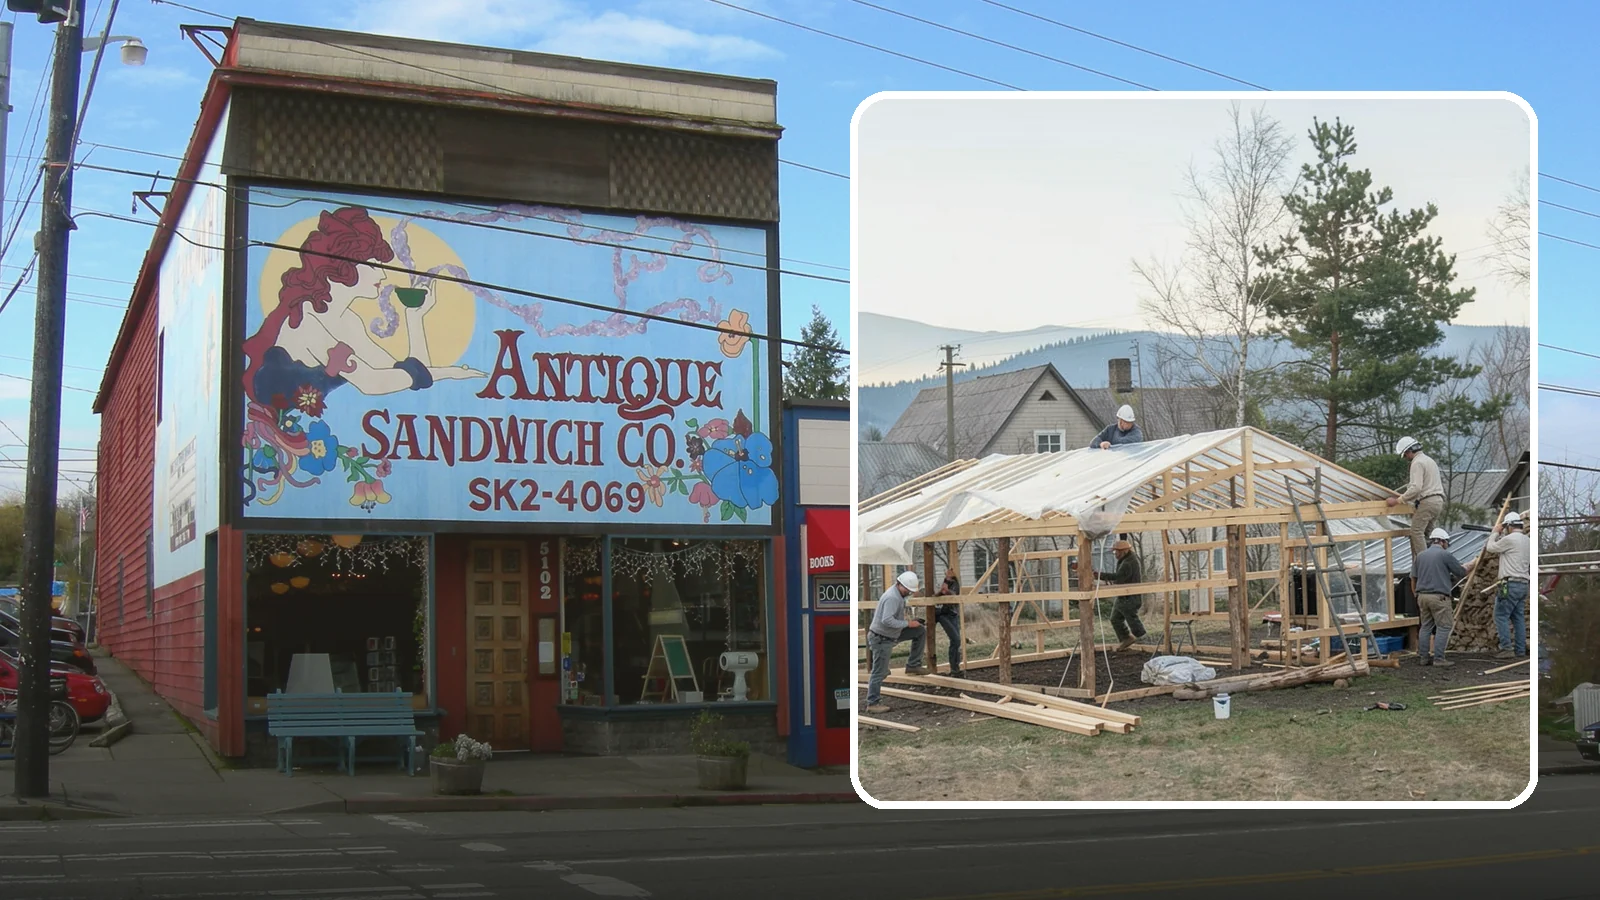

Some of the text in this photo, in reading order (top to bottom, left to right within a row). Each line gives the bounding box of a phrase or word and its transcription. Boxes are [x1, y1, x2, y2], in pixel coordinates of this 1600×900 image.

[476, 329, 722, 421] ANTIQUE
[361, 408, 686, 470] SANDWICH CO.
[468, 475, 647, 514] SK2-4069
[539, 541, 552, 600] 5102
[809, 555, 835, 569] BOOKS
